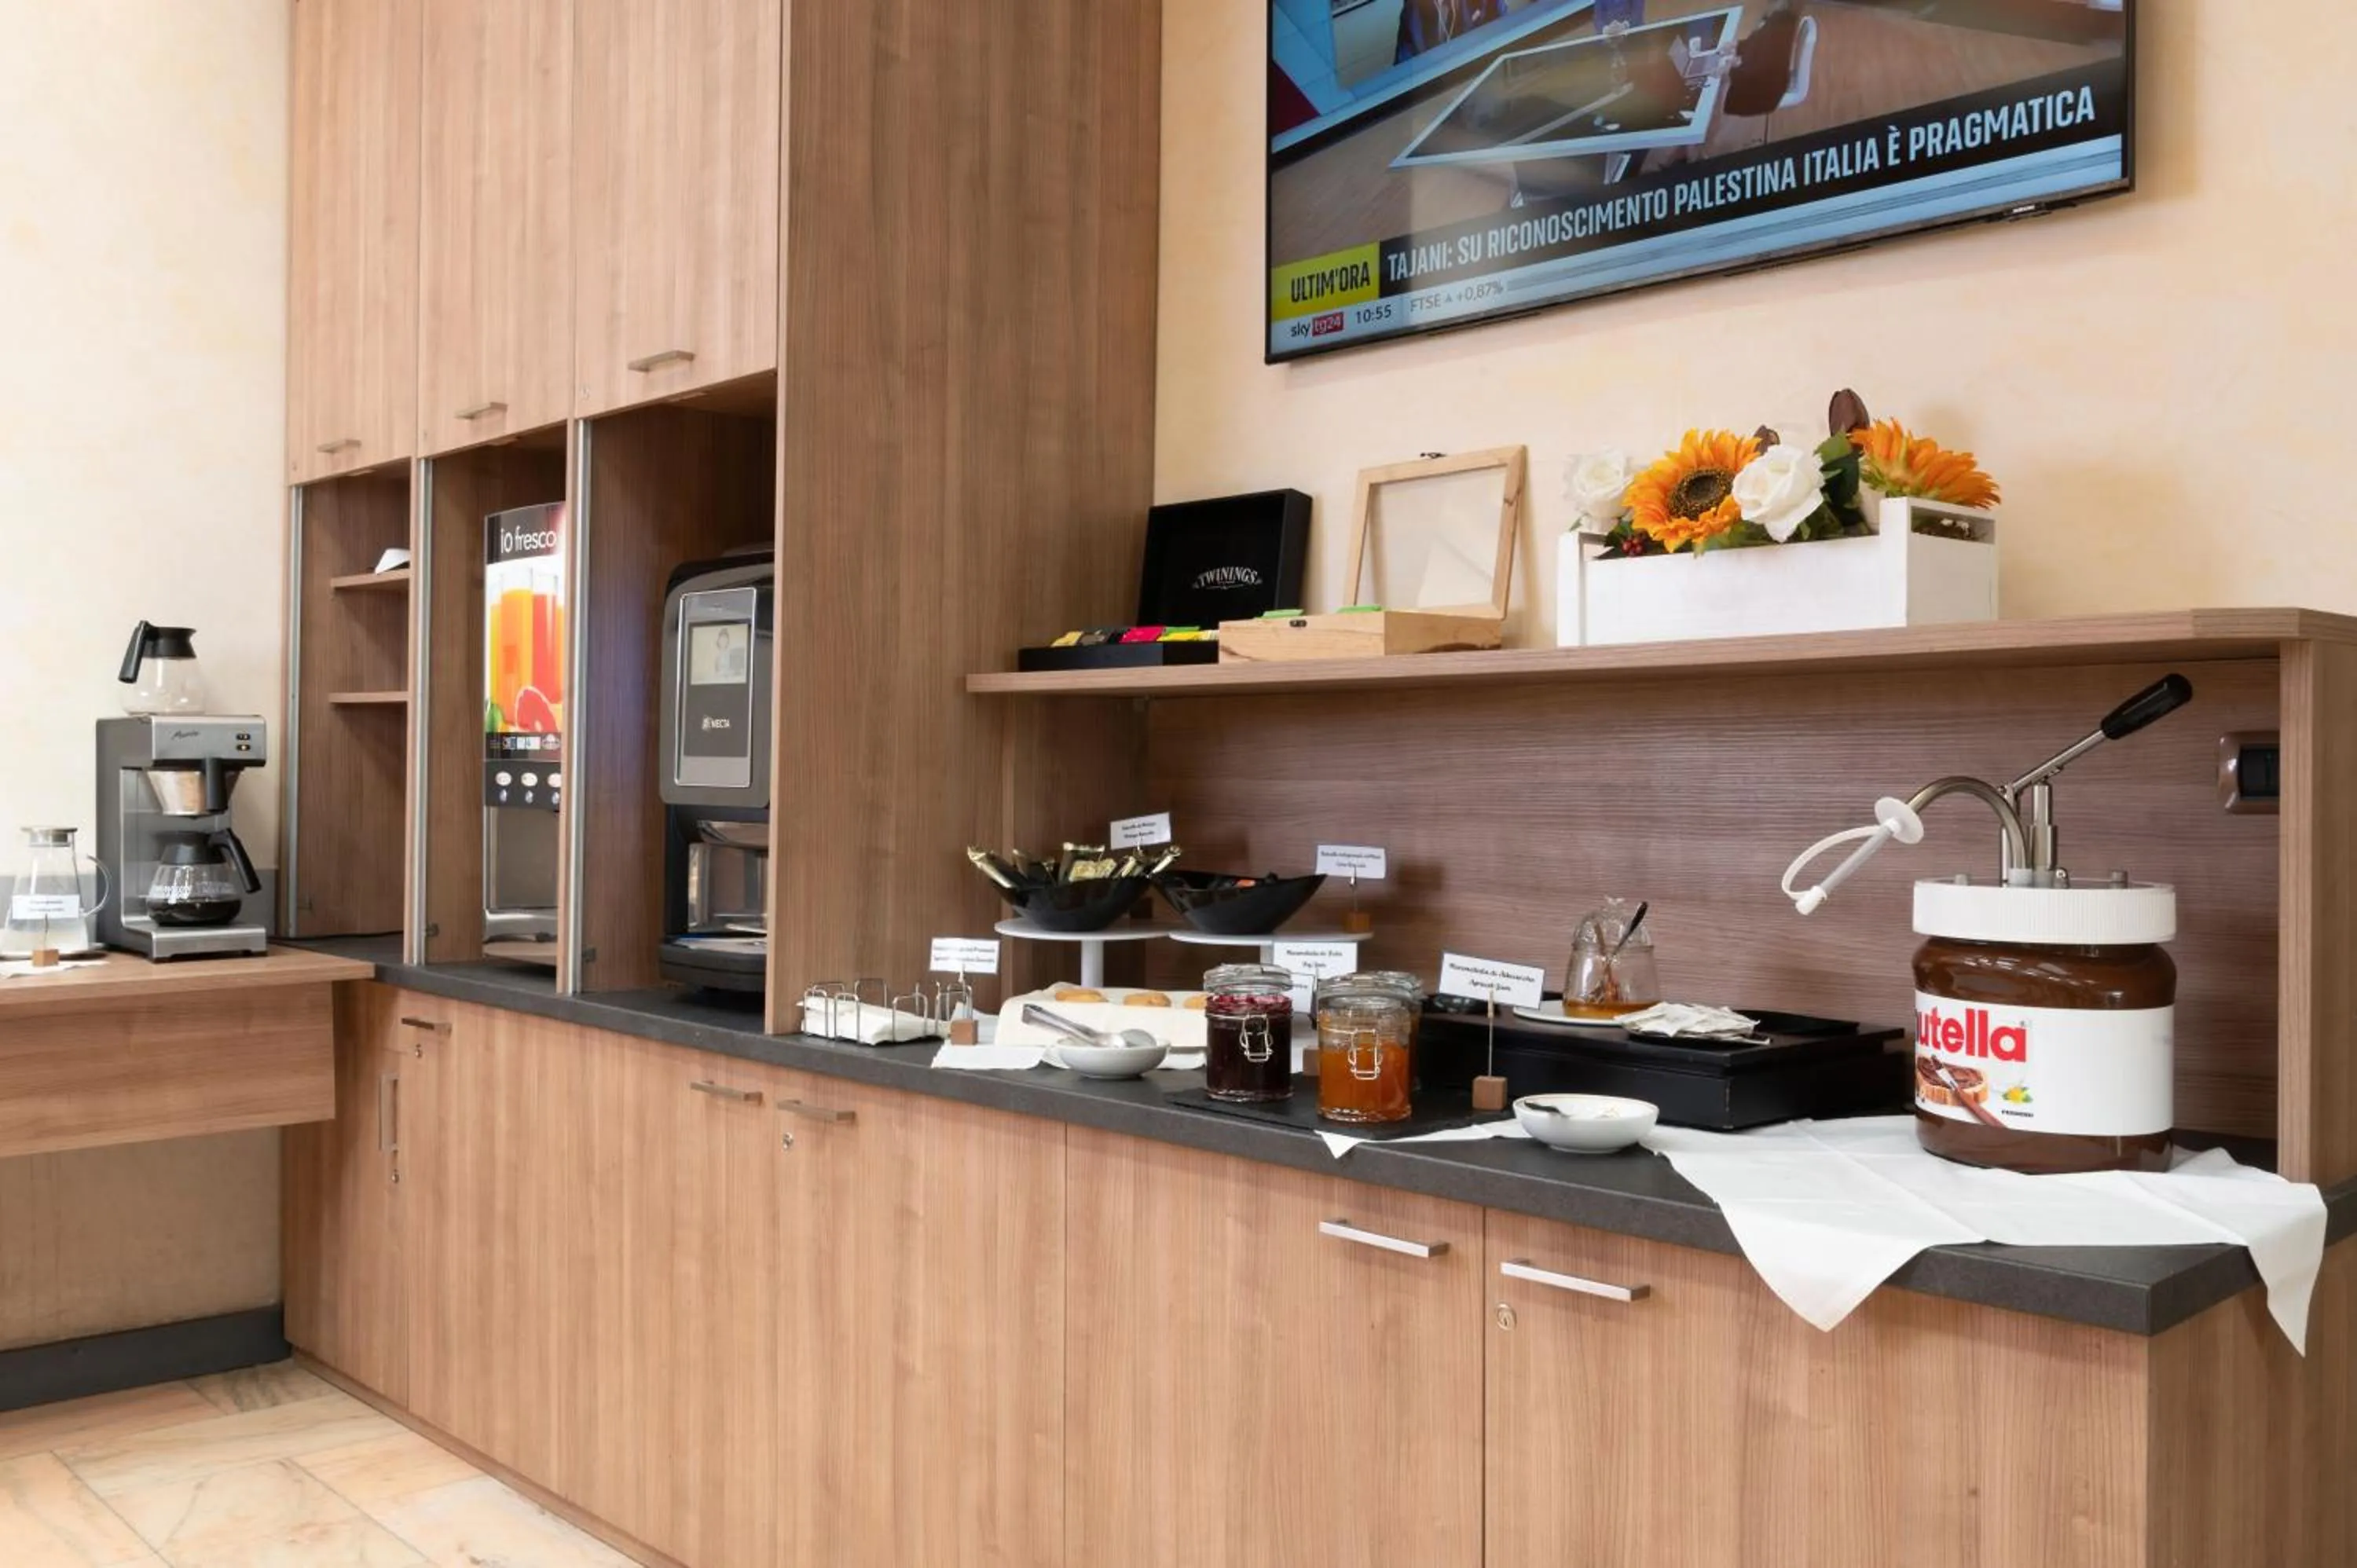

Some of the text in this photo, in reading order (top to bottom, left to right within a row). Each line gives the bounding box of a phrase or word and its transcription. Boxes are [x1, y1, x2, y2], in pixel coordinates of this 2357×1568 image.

[1387, 85, 2096, 282] TAJANI: SU RICONOSCIMENTO PALESTINA ITALIA È PRAGMATICA
[1290, 261, 1371, 303] ULTIM'ORA
[1290, 321, 1311, 339] sky
[1355, 304, 1391, 324] 10:55
[1409, 293, 1442, 313] FTSE
[515, 525, 557, 552] fresco
[1197, 566, 1259, 588] TWININGS
